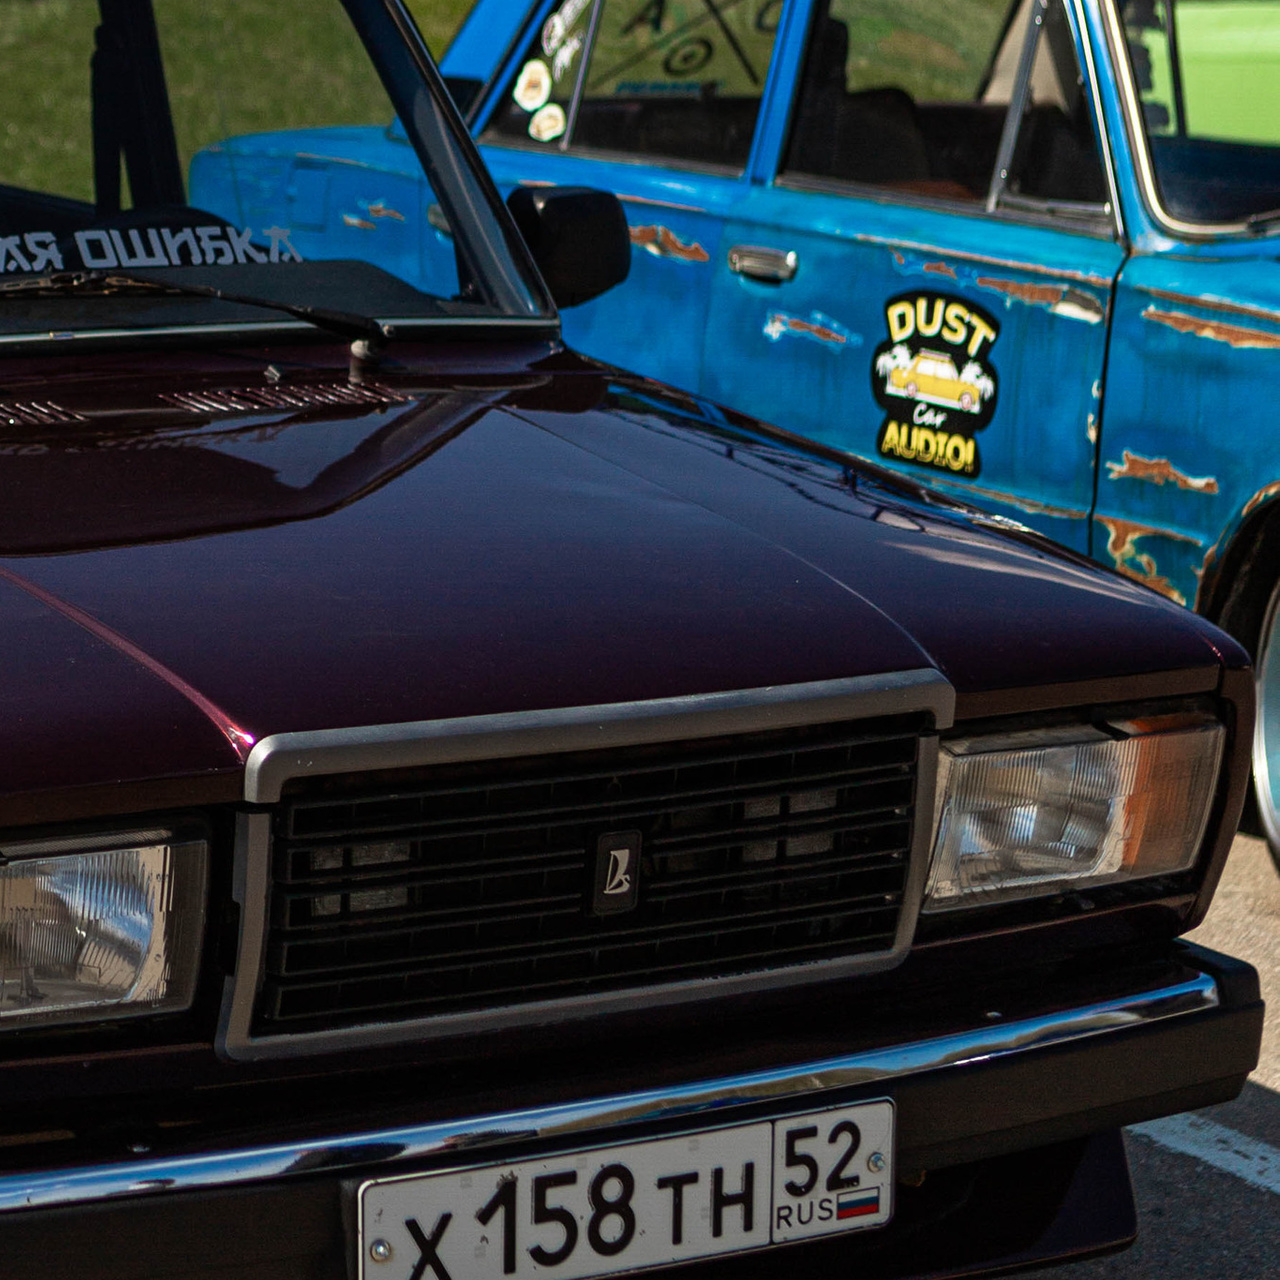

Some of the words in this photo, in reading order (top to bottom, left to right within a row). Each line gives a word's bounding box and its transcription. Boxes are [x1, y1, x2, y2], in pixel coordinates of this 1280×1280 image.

[74, 226, 304, 269] ОШИБКА
[887, 296, 997, 358] DUST
[913, 402, 948, 428] Car
[881, 420, 976, 473] AUDIO!
[784, 1120, 861, 1197] 52
[776, 1198, 834, 1230] RUS
